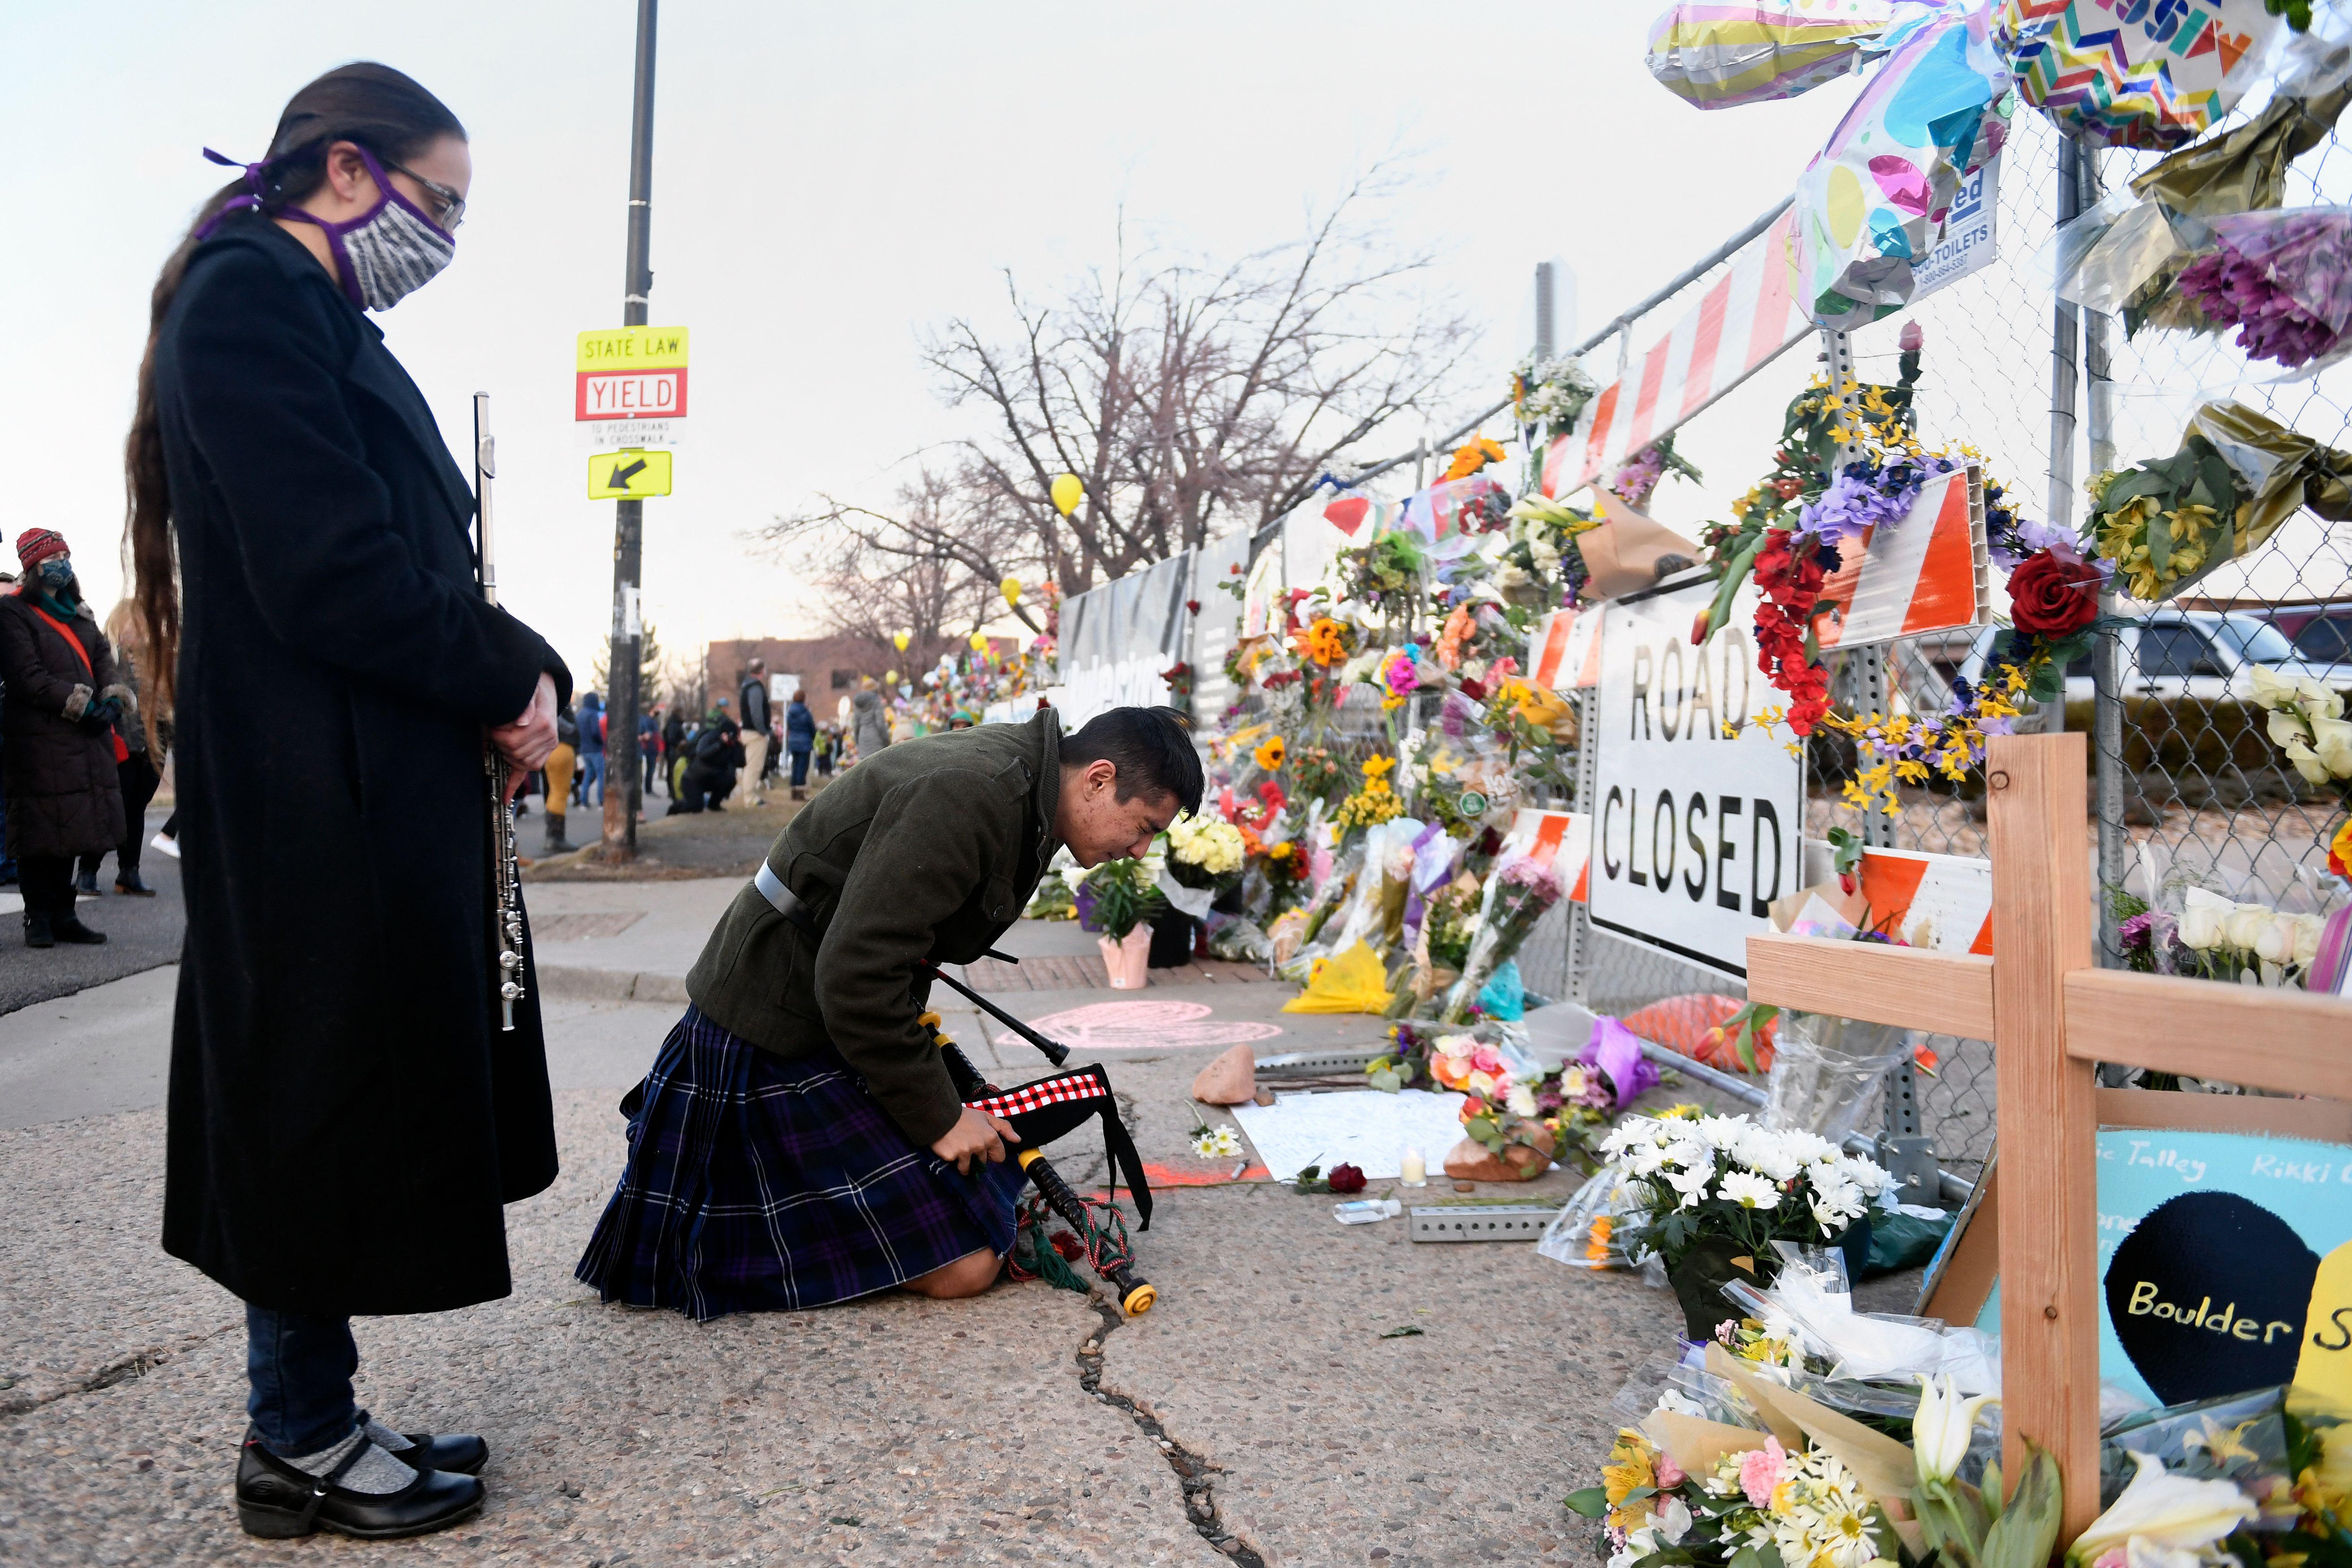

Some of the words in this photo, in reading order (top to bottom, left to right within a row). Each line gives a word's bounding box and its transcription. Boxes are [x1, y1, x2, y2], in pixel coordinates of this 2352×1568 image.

[586, 339, 633, 358] STATE
[646, 338, 680, 355] LAW
[593, 380, 672, 408] YIELD
[591, 423, 601, 433] TO
[608, 422, 669, 432] PEDESTRIANS
[596, 436, 604, 445] IN
[610, 434, 664, 444] CROSSWALK
[1630, 628, 1750, 743] ROAD
[1603, 785, 1782, 918] CLOSED
[2128, 1141, 2206, 1182] Talley
[2252, 1154, 2331, 1183] Rikki
[2128, 1281, 2292, 1344] Boulder
